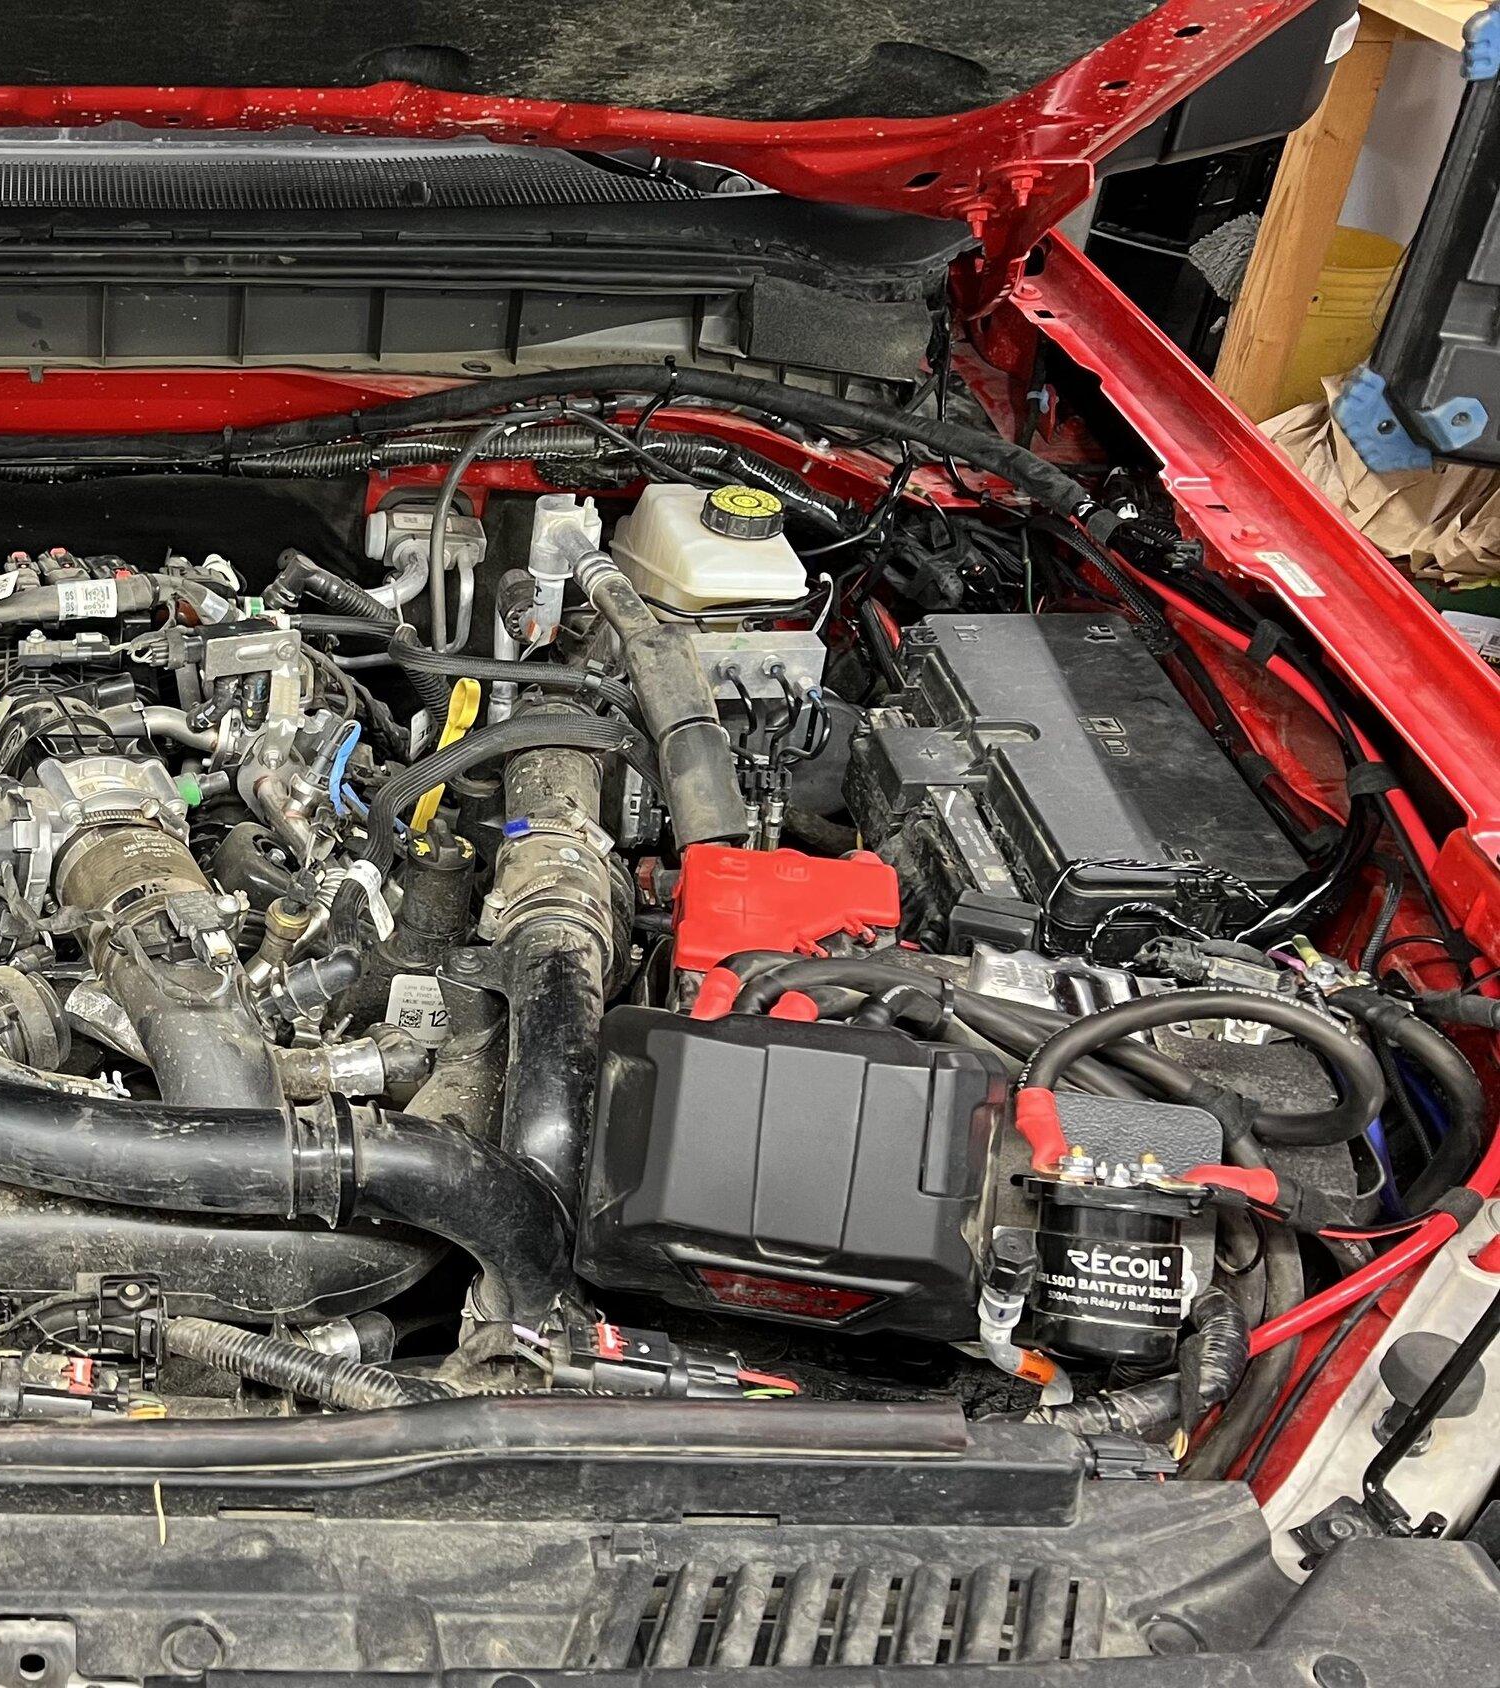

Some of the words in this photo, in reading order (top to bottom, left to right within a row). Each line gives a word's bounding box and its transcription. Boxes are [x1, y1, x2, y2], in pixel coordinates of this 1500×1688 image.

[428, 1010, 448, 1027] 12
[1067, 1248, 1169, 1281] RECOIL
[1077, 1277, 1148, 1297] BATTERY
[1089, 1296, 1122, 1311] Relay
[1128, 1301, 1161, 1314] Battery
